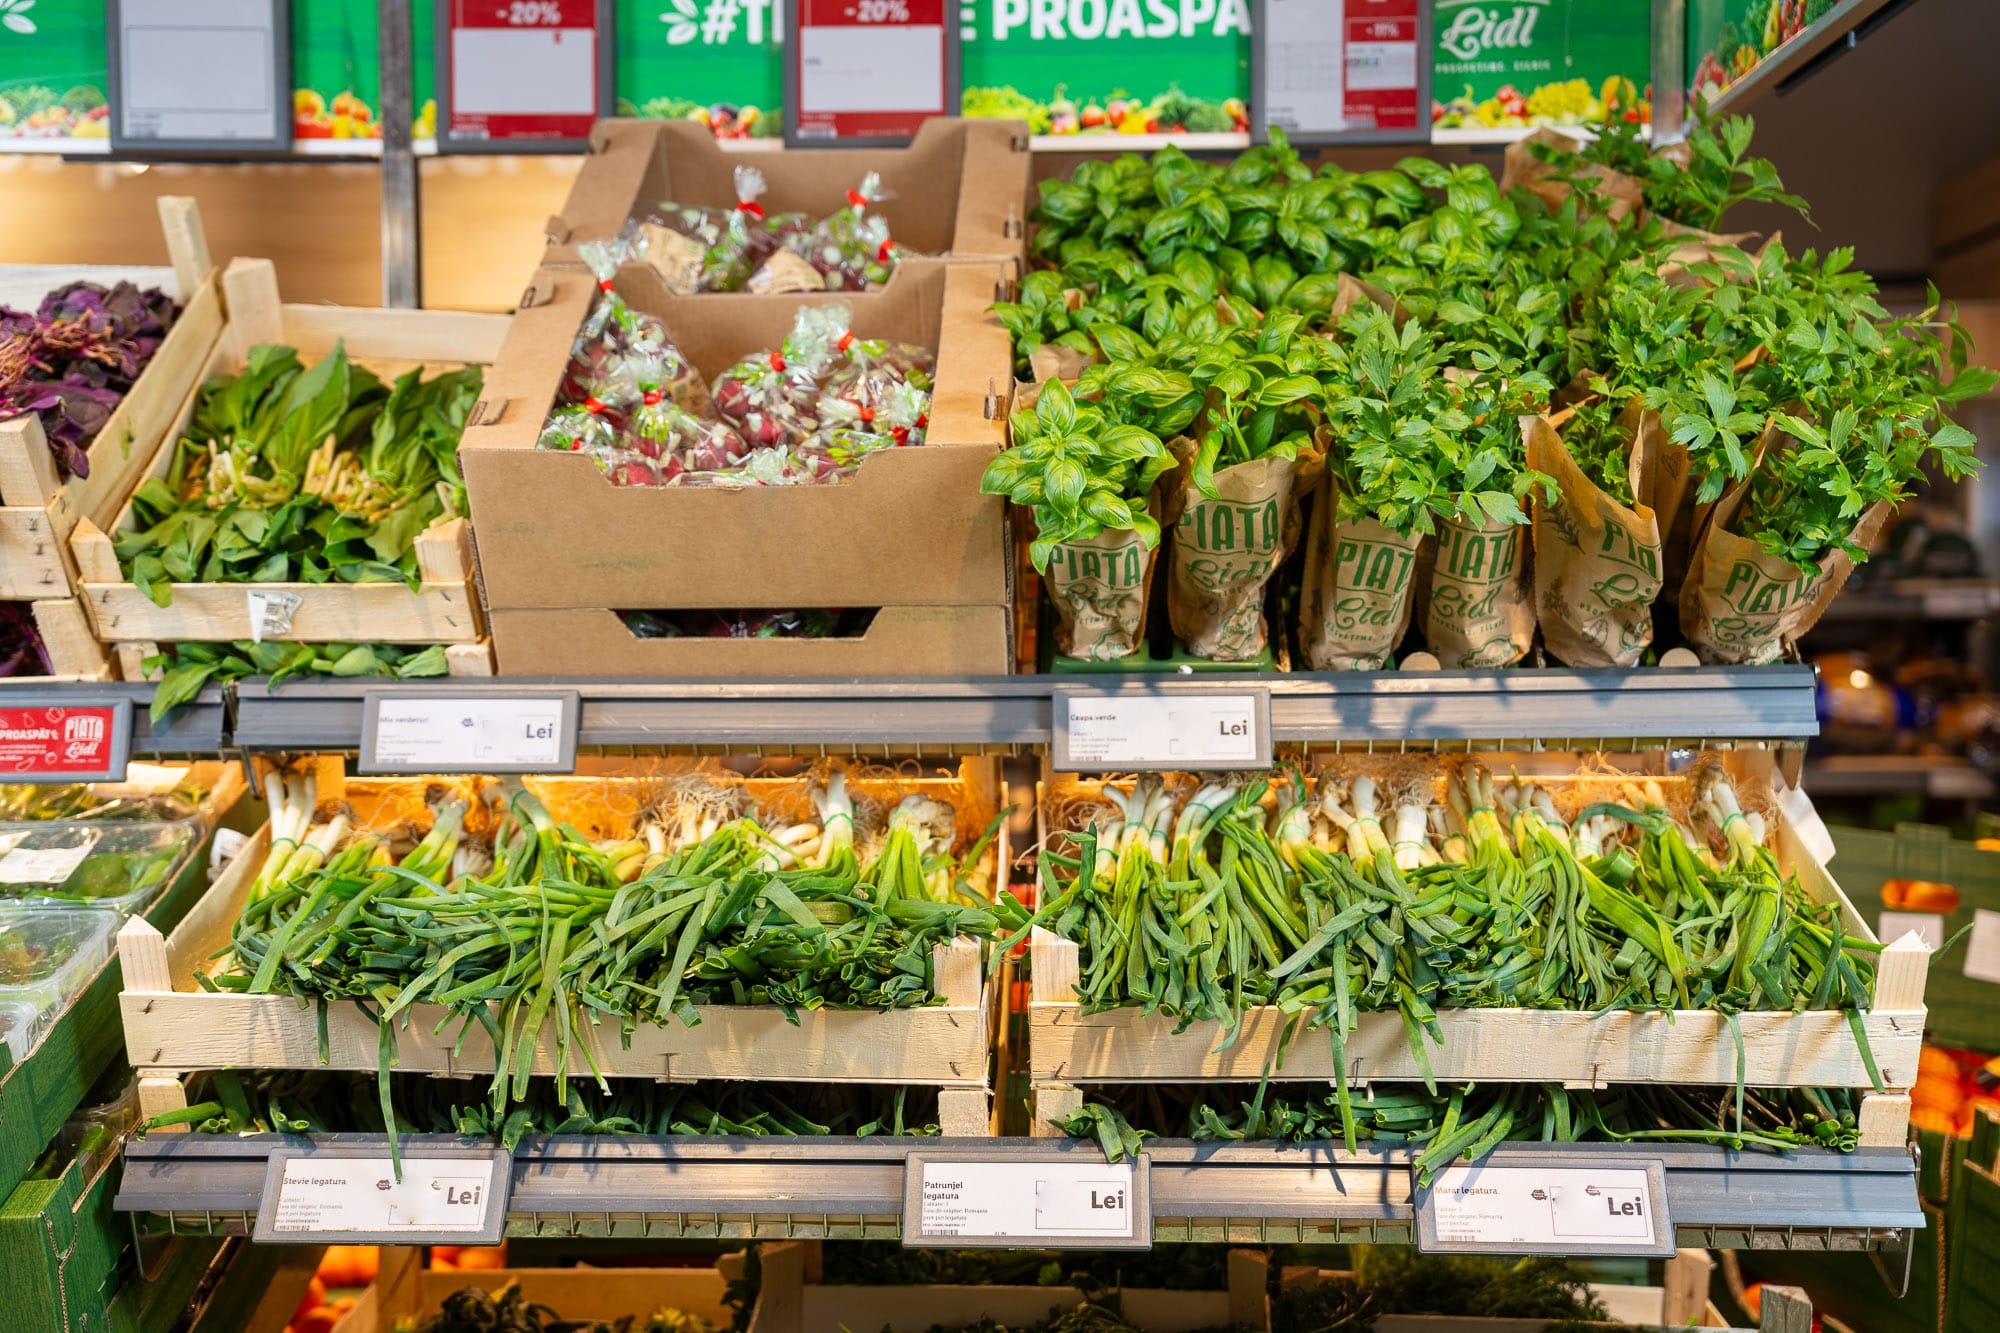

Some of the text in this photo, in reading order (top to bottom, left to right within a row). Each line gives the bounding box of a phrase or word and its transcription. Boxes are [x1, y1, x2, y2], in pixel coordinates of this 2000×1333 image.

[496, 1, 562, 25] -20%
[844, 0, 910, 22] -20%
[1440, 6, 1539, 60] Lidl
[1432, 585, 1502, 619] Lidl
[526, 723, 553, 739] Lei
[1219, 720, 1247, 736] Lei
[65, 742, 98, 759] Lidl
[282, 1177, 346, 1187] Stevie legatura
[924, 1181, 963, 1191] Patrunjel
[1434, 1185, 1498, 1196] Marar legatura
[446, 1186, 481, 1205] Lei
[923, 1191, 959, 1201] legatura
[1091, 1190, 1124, 1209] Lei
[1607, 1196, 1643, 1216] Lei
